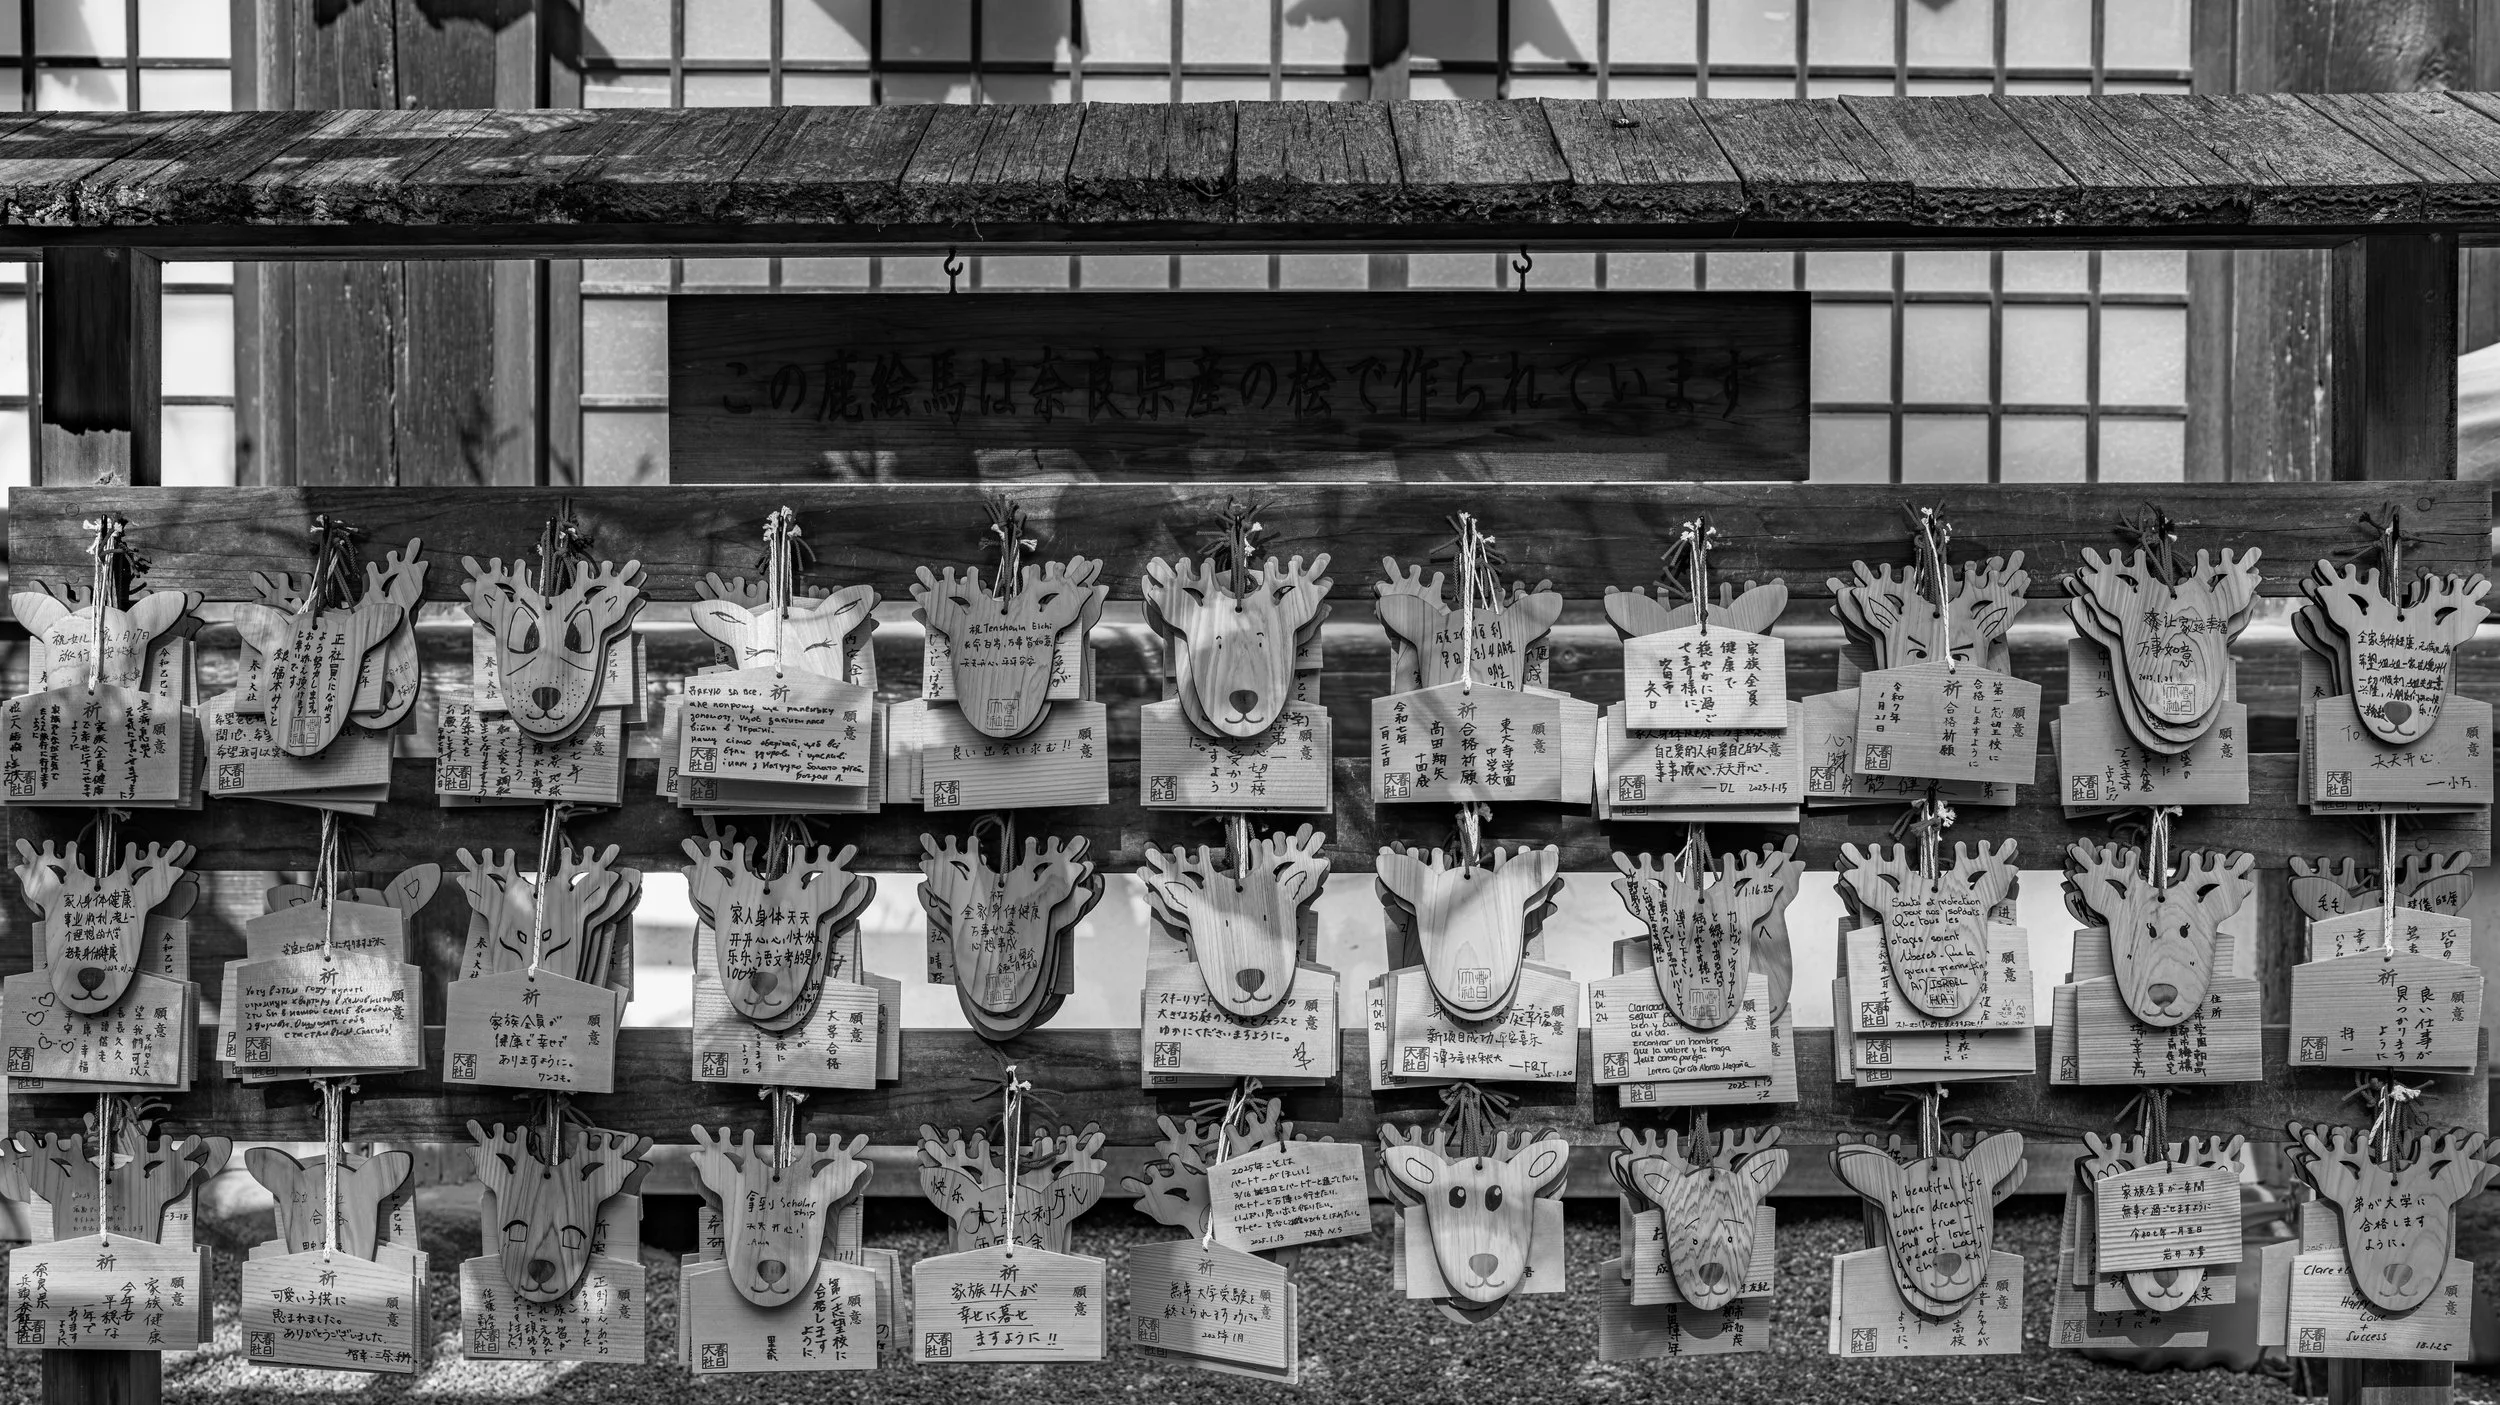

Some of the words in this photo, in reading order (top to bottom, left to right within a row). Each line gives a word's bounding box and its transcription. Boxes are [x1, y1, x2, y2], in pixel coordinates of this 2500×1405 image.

[2137, 633, 2194, 668] 万事如意
[1720, 641, 1738, 688] 健康で
[1744, 641, 1761, 707] 家族全員
[770, 684, 790, 703] 祈
[1942, 680, 1963, 700] 祈
[82, 702, 102, 720] 祈
[1457, 702, 1477, 721] 祈
[1988, 681, 2004, 761] 第一志望校に
[1393, 701, 1408, 745] 令和七年
[1939, 701, 1958, 757] 合格祈願
[1968, 679, 1984, 768] 合格しますように
[1379, 725, 1391, 767] 一月二十日
[1458, 722, 1479, 785] 合格祈願
[1500, 718, 1516, 786] 東大寺学園
[1485, 747, 1501, 786] 中学校
[1744, 886, 1773, 897] 1.16.25
[1926, 898, 1935, 906] et
[1892, 914, 1915, 929] Que
[1945, 911, 1959, 923] les
[320, 968, 338, 986] 祈
[2378, 968, 2397, 986] 祈
[523, 988, 541, 1007] 祈
[2210, 994, 2222, 1019] 住所
[489, 1014, 563, 1030] 家族全員が
[2416, 986, 2434, 1060] 良い仕事が
[826, 1010, 842, 1070] 大学合格
[1688, 1037, 1719, 1047] hombre
[2377, 1026, 2388, 1061] ように
[931, 1174, 964, 1204] 快乐
[1891, 1190, 1899, 1202] A
[1905, 1177, 1954, 1197] beautiful
[1961, 1172, 1982, 1192] life
[2121, 1180, 2205, 1200] 家族全員が一年間
[1893, 1205, 1925, 1219] where
[1932, 1197, 1974, 1212] dreams
[2121, 1201, 2212, 1219] 無事で過ごせますように
[2353, 1193, 2425, 1213] 弟が大学に
[1896, 1225, 1924, 1237] come
[1931, 1218, 1957, 1230] true
[2360, 1215, 2425, 1233] 合格します
[1899, 1237, 1919, 1254] full
[1927, 1231, 1940, 1245] of
[1948, 1229, 1971, 1240] love
[97, 1254, 116, 1272] 祈
[1198, 1258, 1214, 1278] 祈
[2304, 1265, 2334, 1276] Clare
[319, 1270, 338, 1289] 祈
[1000, 1264, 1019, 1284] 祈
[32, 1262, 49, 1309] 奈良県
[951, 1283, 1038, 1299] 家族4人が
[120, 1282, 136, 1322] 今年も
[270, 1287, 346, 1306] 可愛い子供に
[101, 1294, 121, 1340] 平穏な
[144, 1277, 165, 1345] 家族健康
[812, 1283, 828, 1354] 合格します
[829, 1278, 849, 1360] 第一志望校に
[957, 1304, 1028, 1323] 幸せに暮せ
[2360, 1312, 2386, 1322] Love
[2346, 1331, 2388, 1342] Success
